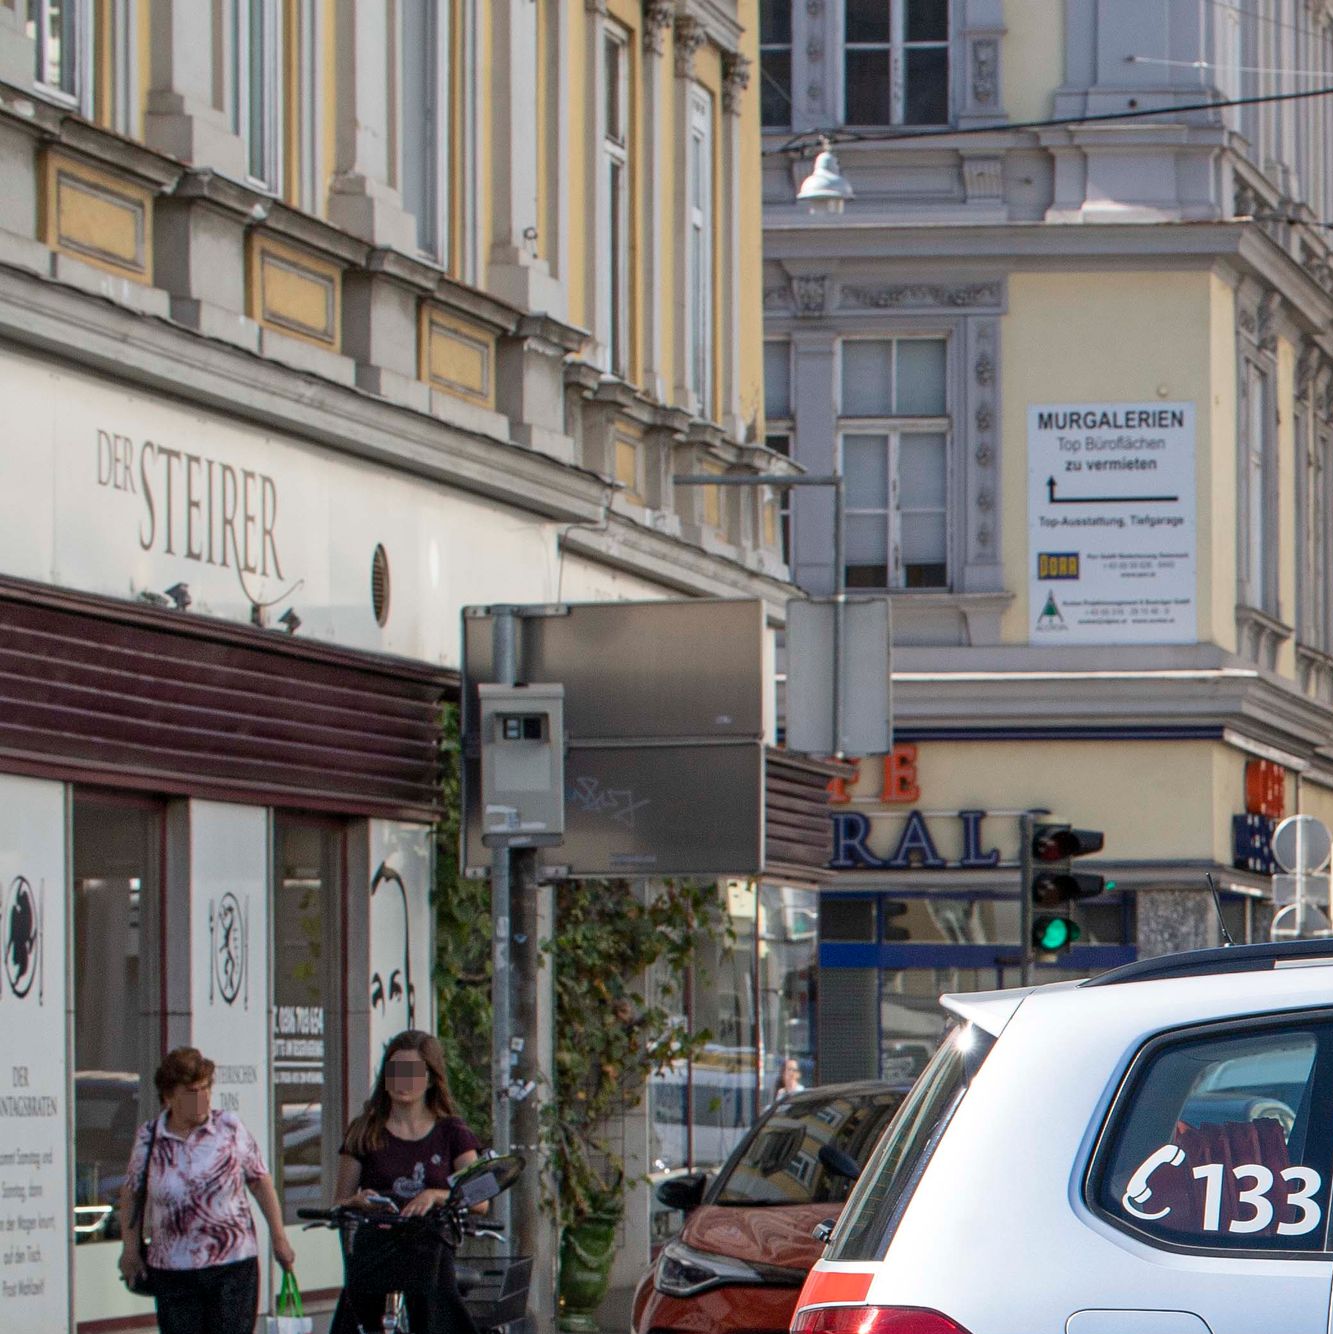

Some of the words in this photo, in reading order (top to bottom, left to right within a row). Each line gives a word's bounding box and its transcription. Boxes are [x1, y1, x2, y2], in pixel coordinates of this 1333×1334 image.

[1038, 410, 1184, 430] MURGALERIEN
[1058, 437, 1081, 453] Top
[1084, 436, 1166, 452] Büroflächen
[1065, 459, 1083, 472] zu
[1087, 457, 1158, 472] vermieten
[96, 429, 136, 494] DER
[139, 440, 304, 607] STEIRER
[1130, 514, 1185, 528] Tiefgarage
[12, 1066, 29, 1087] DER
[215, 1065, 257, 1085] TEIRISCHEN
[1192, 1163, 1321, 1237] 133
